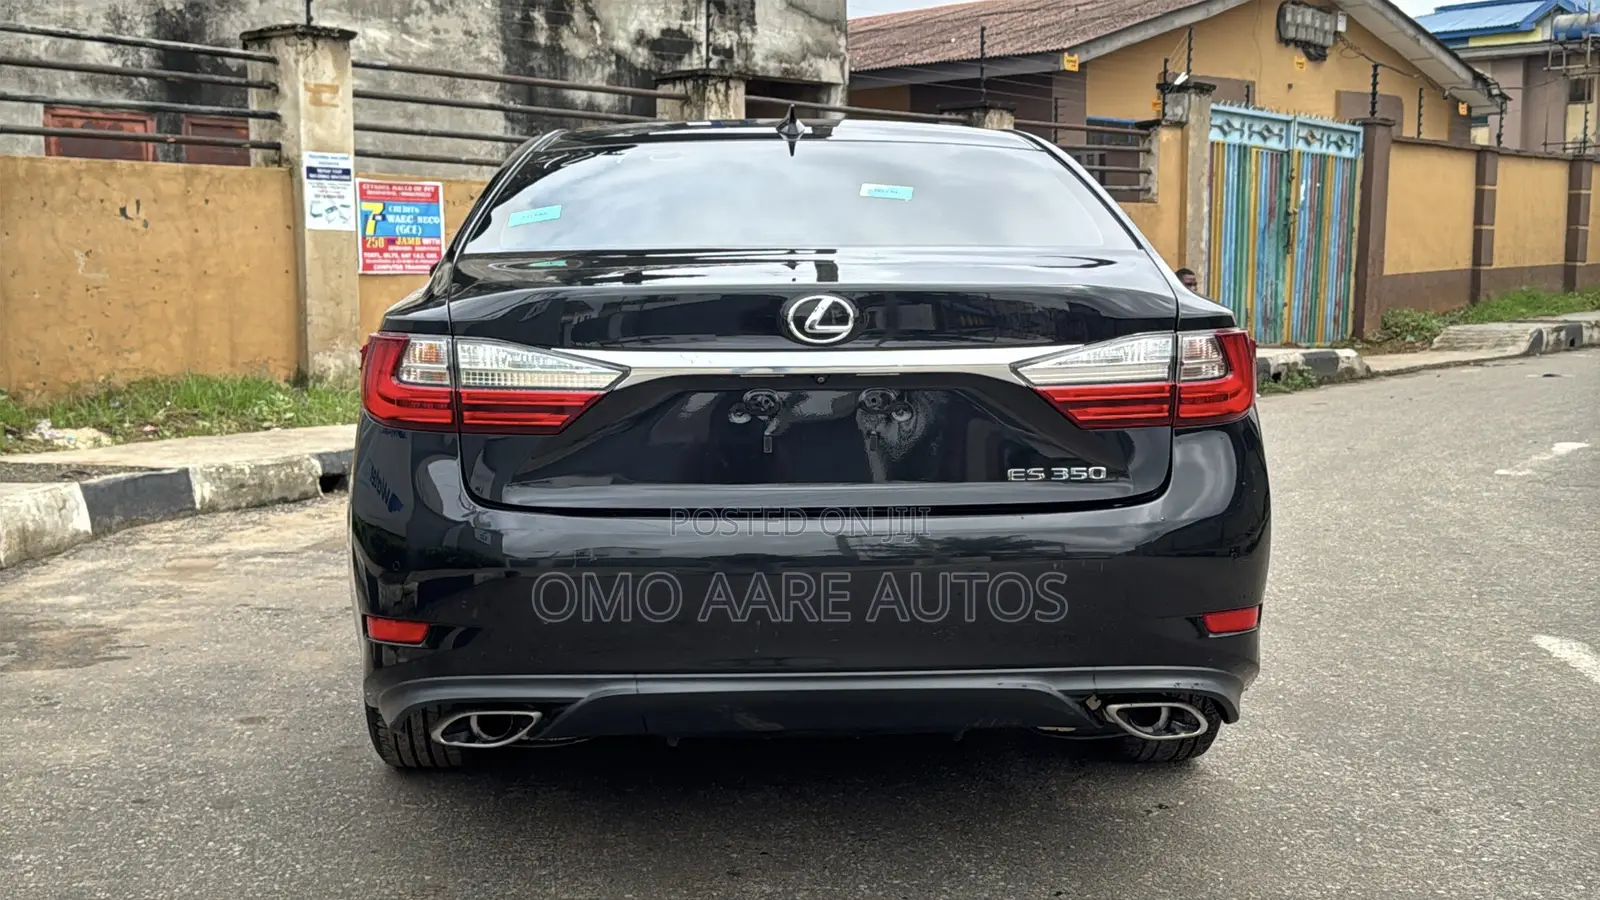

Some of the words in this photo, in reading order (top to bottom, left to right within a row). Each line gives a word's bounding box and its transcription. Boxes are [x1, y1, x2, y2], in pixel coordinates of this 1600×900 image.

[388, 205, 420, 213] CREDITS
[361, 201, 385, 236] 7
[386, 215, 414, 223] WAEC
[417, 216, 440, 224] NECO
[366, 237, 385, 249] 250
[395, 237, 421, 246] JAMB
[1007, 467, 1046, 481] ES
[1050, 466, 1107, 480] 350
